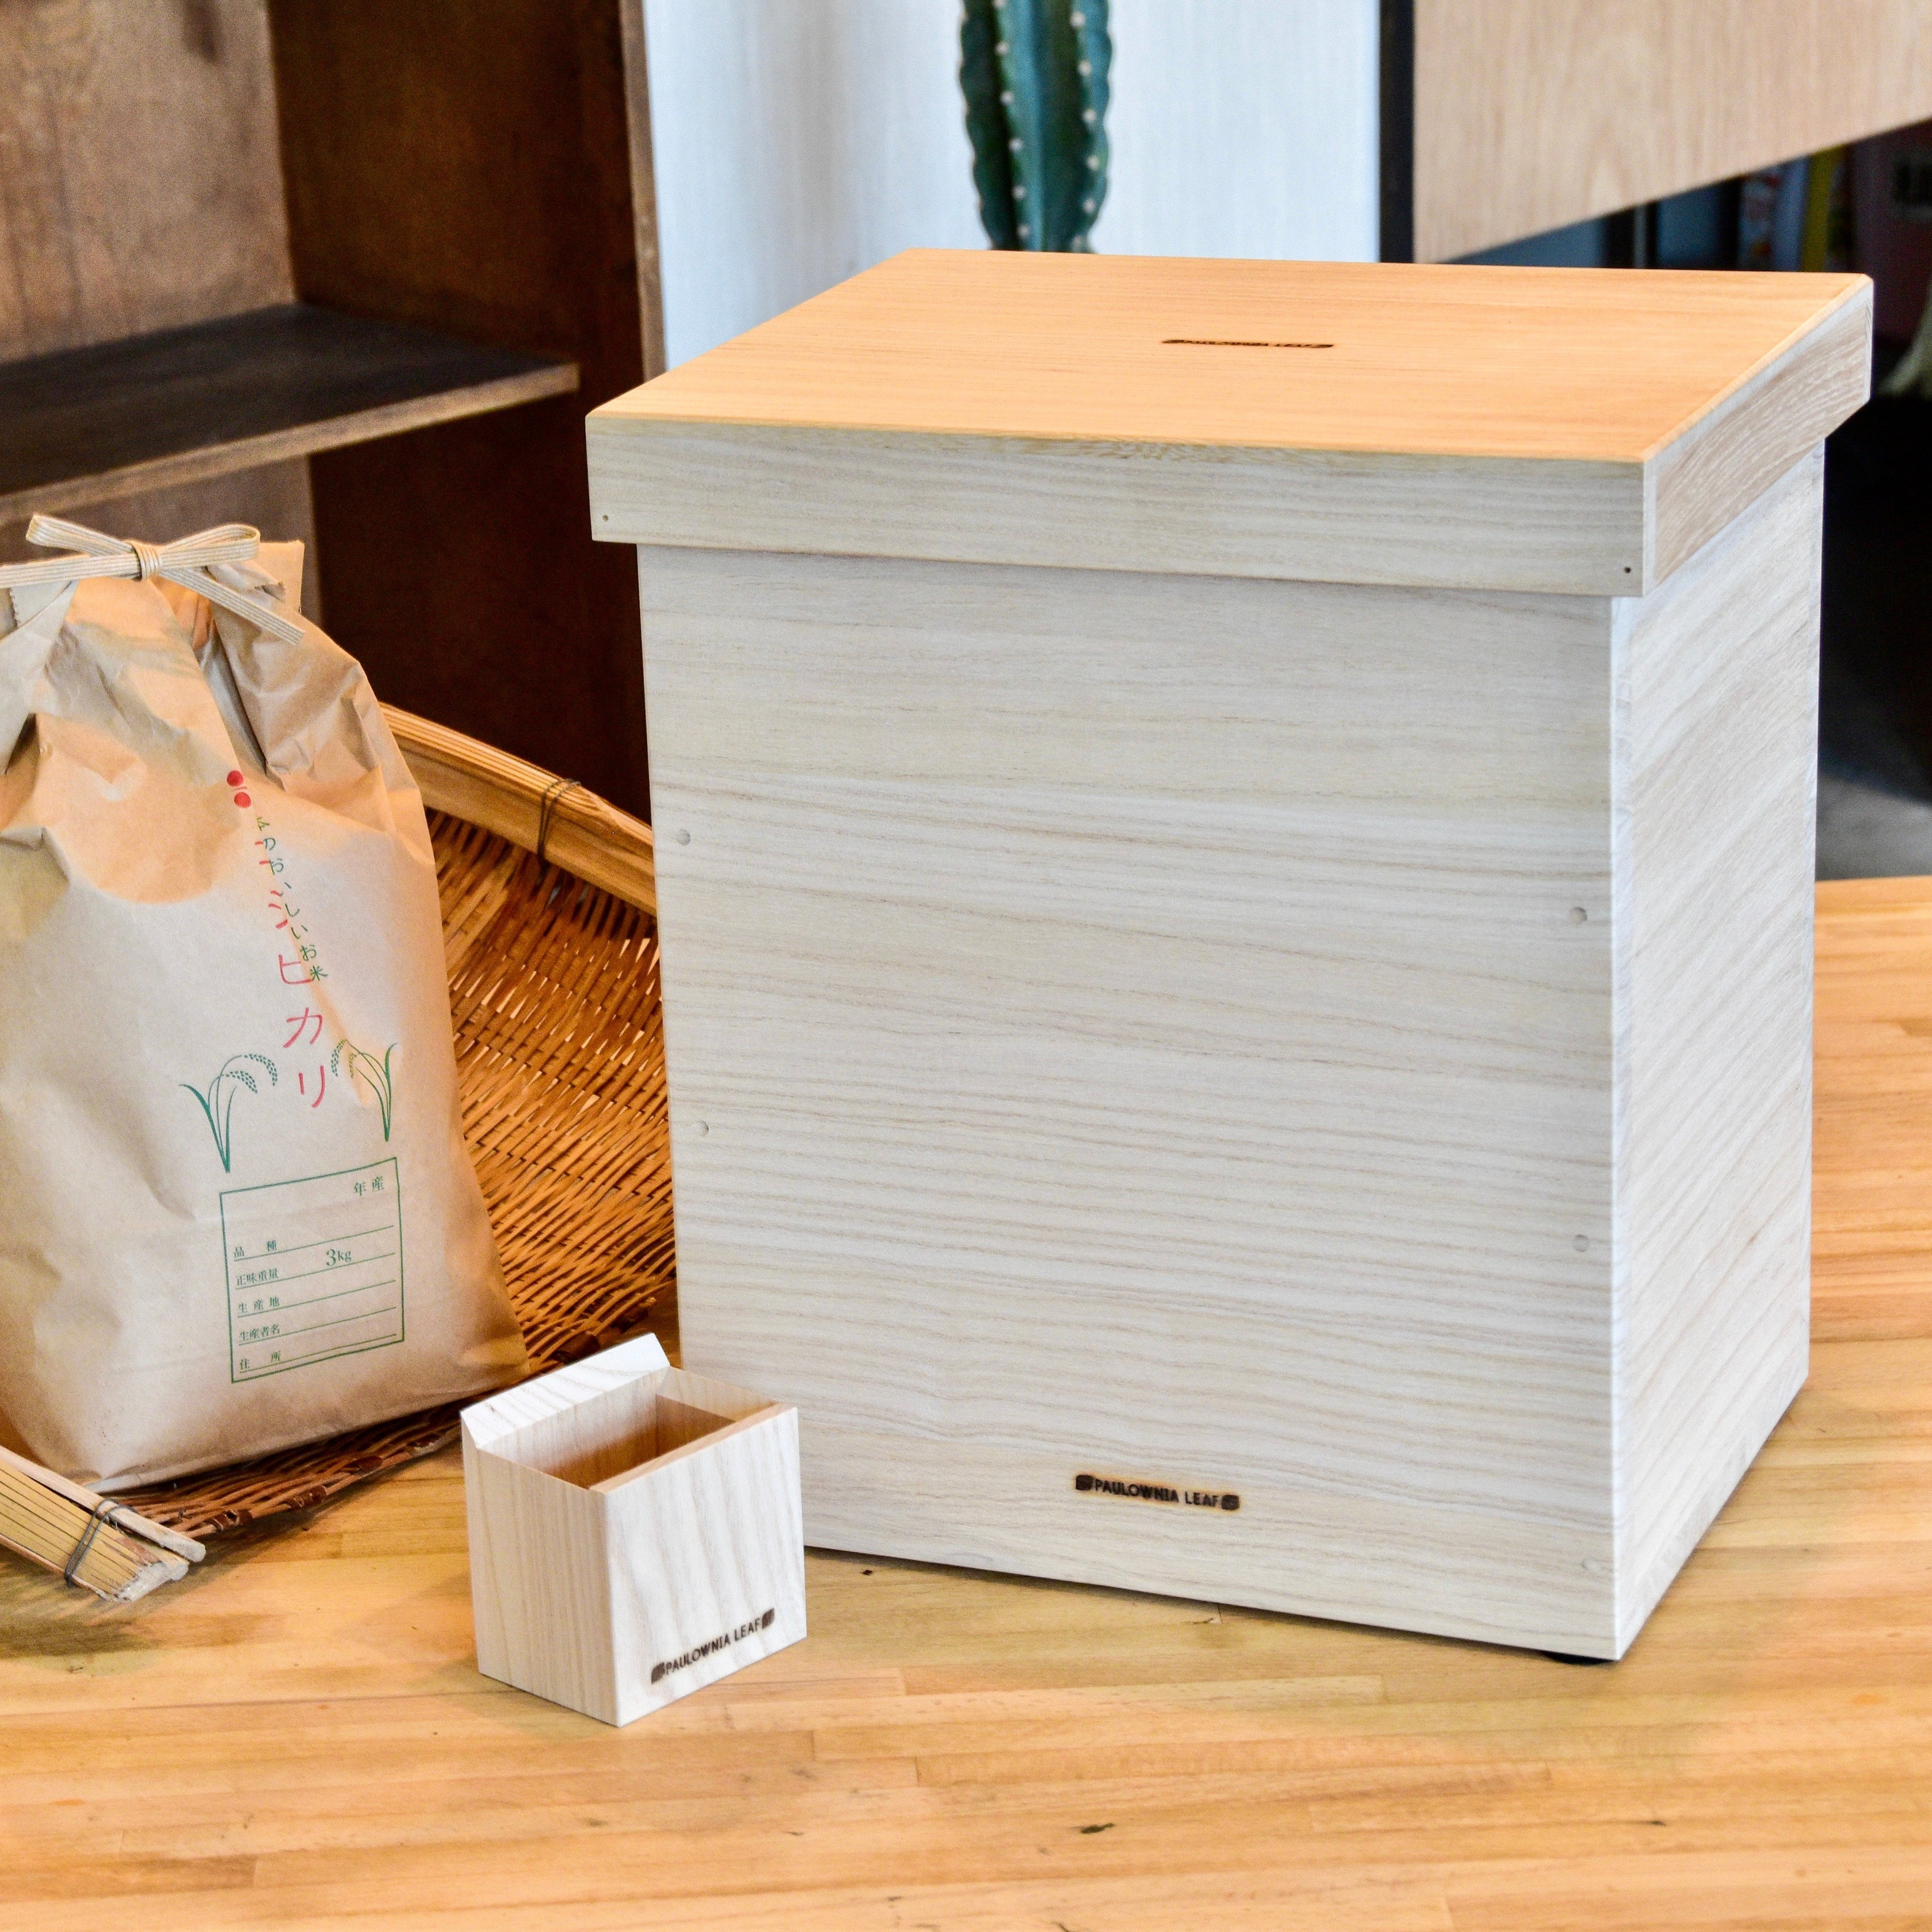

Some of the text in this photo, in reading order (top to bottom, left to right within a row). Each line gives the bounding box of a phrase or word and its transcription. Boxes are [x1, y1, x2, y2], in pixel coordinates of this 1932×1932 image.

[237, 1249, 352, 1285] 正味重量 3kg
[239, 1324, 280, 1342] 生産者名
[1095, 1478, 1219, 1507] PAULOWNIA LEAF
[665, 1618, 760, 1675] PAULOWNIA LEAF
